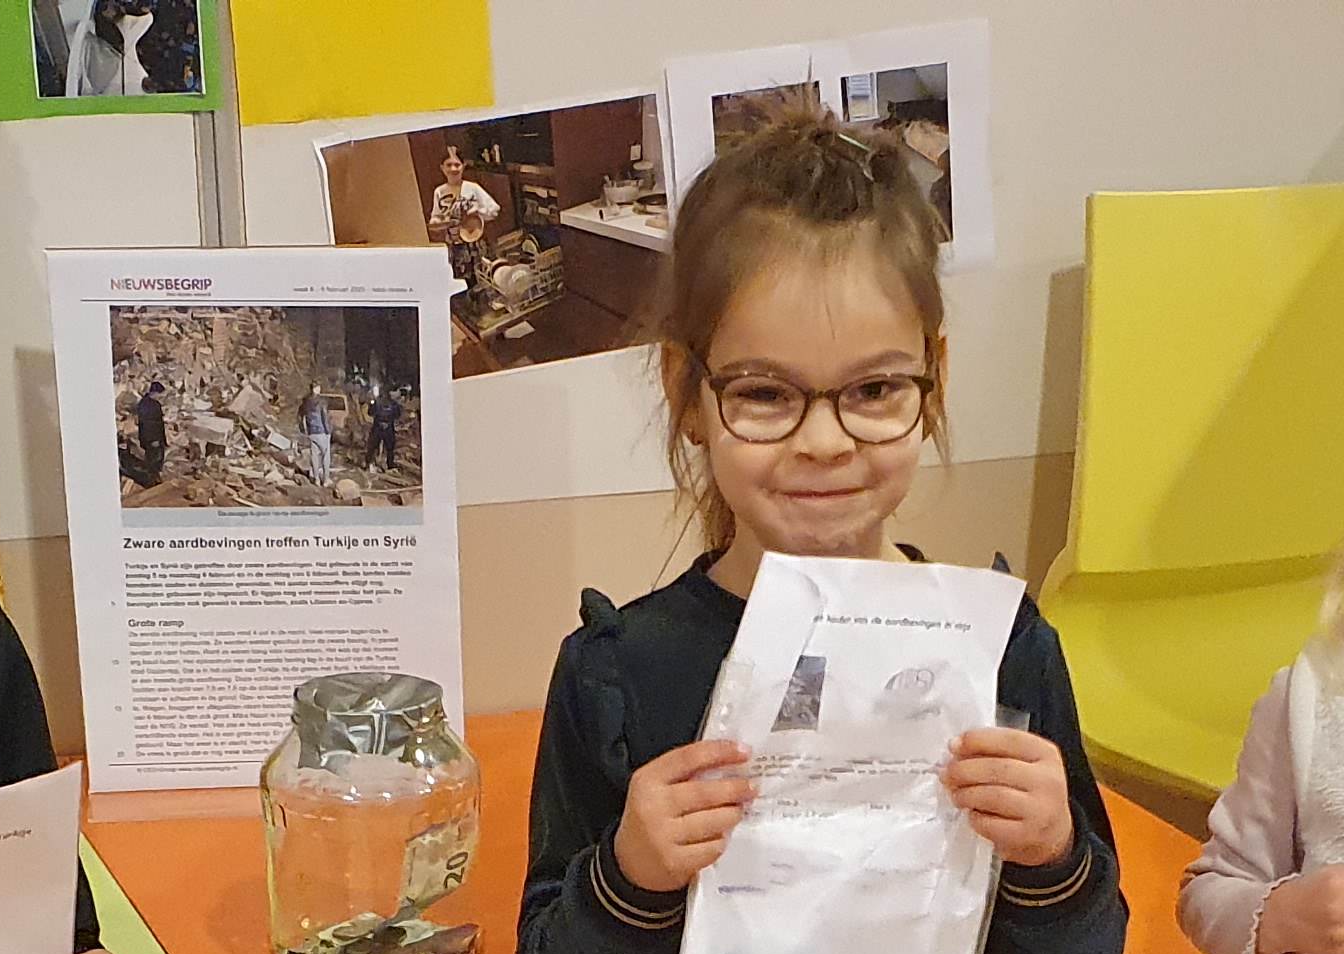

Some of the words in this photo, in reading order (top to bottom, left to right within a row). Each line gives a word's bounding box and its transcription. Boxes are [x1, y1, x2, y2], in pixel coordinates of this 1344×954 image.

[109, 278, 213, 291] NIEUWSBEGRIP
[123, 538, 165, 549] Zware
[169, 536, 262, 550] aardbevingen
[266, 535, 310, 548] treffen
[313, 535, 359, 549] Turkije
[363, 538, 379, 547] en
[383, 535, 417, 549] Syrië
[128, 619, 156, 627] Grote
[158, 619, 184, 628] ramp
[443, 851, 469, 889] 20
